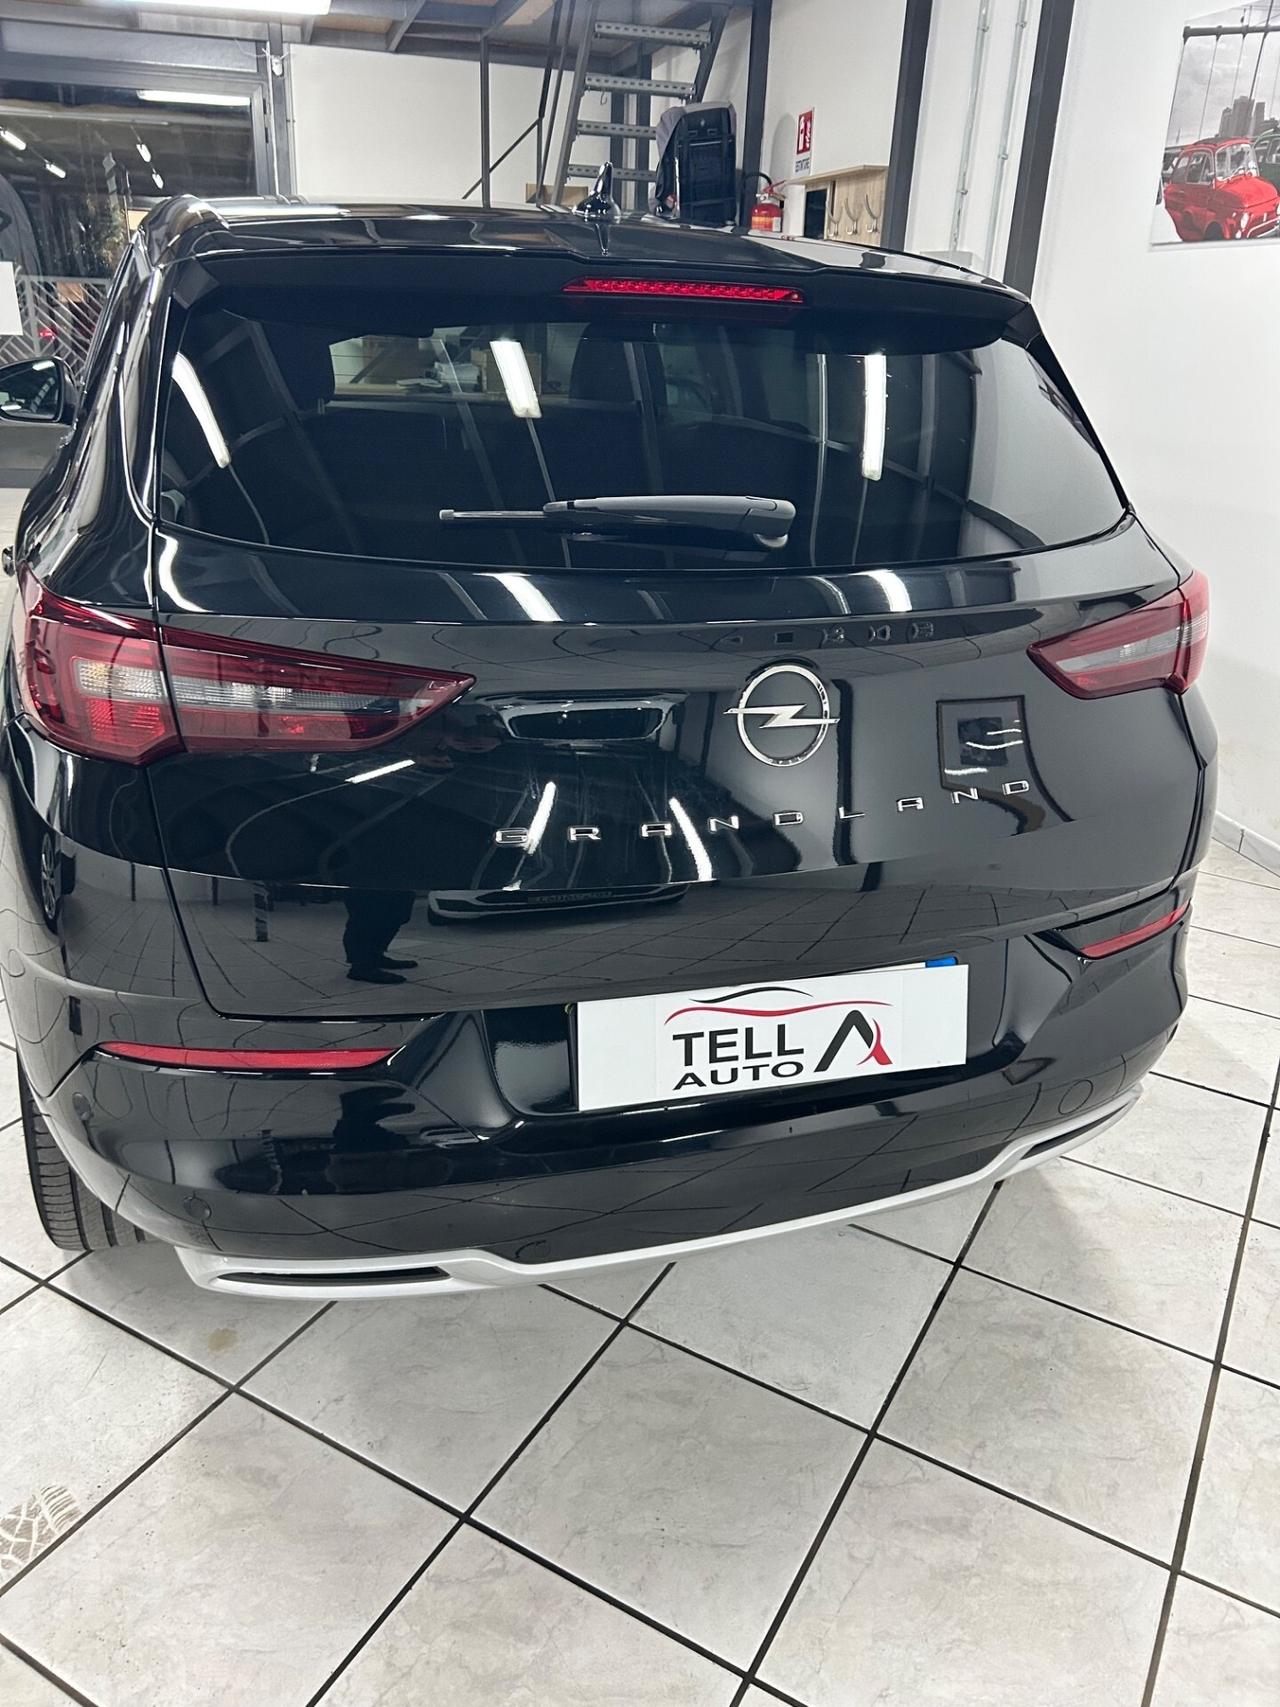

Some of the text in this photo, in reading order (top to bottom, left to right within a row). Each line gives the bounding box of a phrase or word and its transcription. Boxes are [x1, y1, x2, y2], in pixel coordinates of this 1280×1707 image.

[495, 780, 1030, 843] GRANDLAND
[672, 1024, 804, 1067] TELL
[672, 1061, 804, 1090] AUTO
